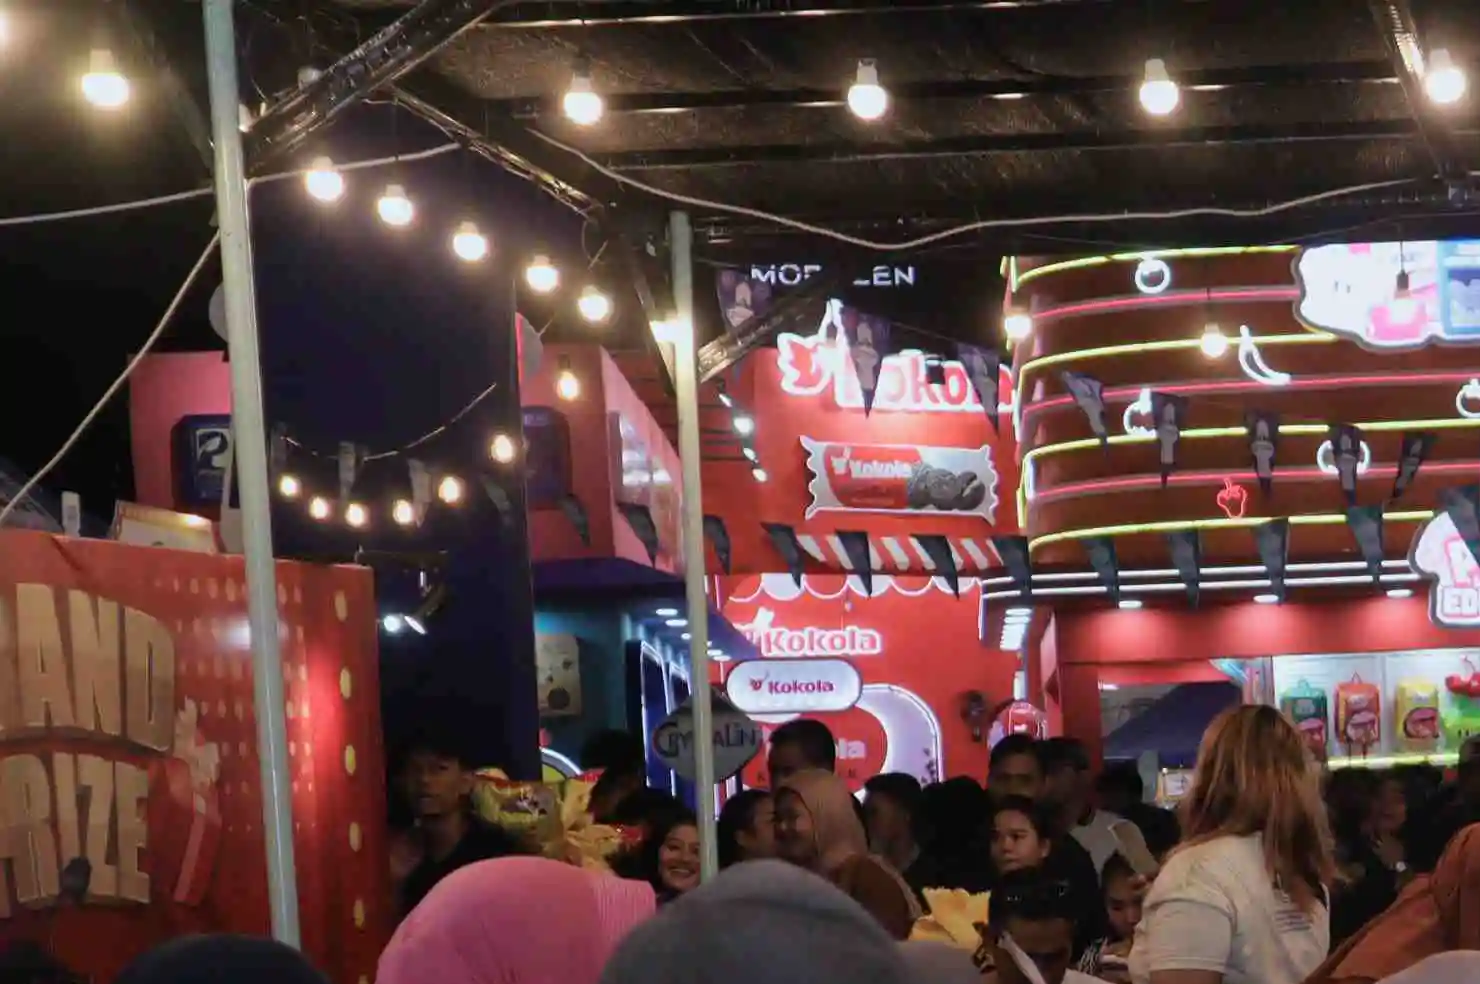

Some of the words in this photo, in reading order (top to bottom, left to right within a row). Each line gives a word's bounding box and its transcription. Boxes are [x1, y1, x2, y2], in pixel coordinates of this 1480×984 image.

[0, 583, 174, 750] AND
[762, 626, 880, 655] Kokola
[768, 678, 835, 695] Kokola
[0, 753, 150, 918] RIZE
